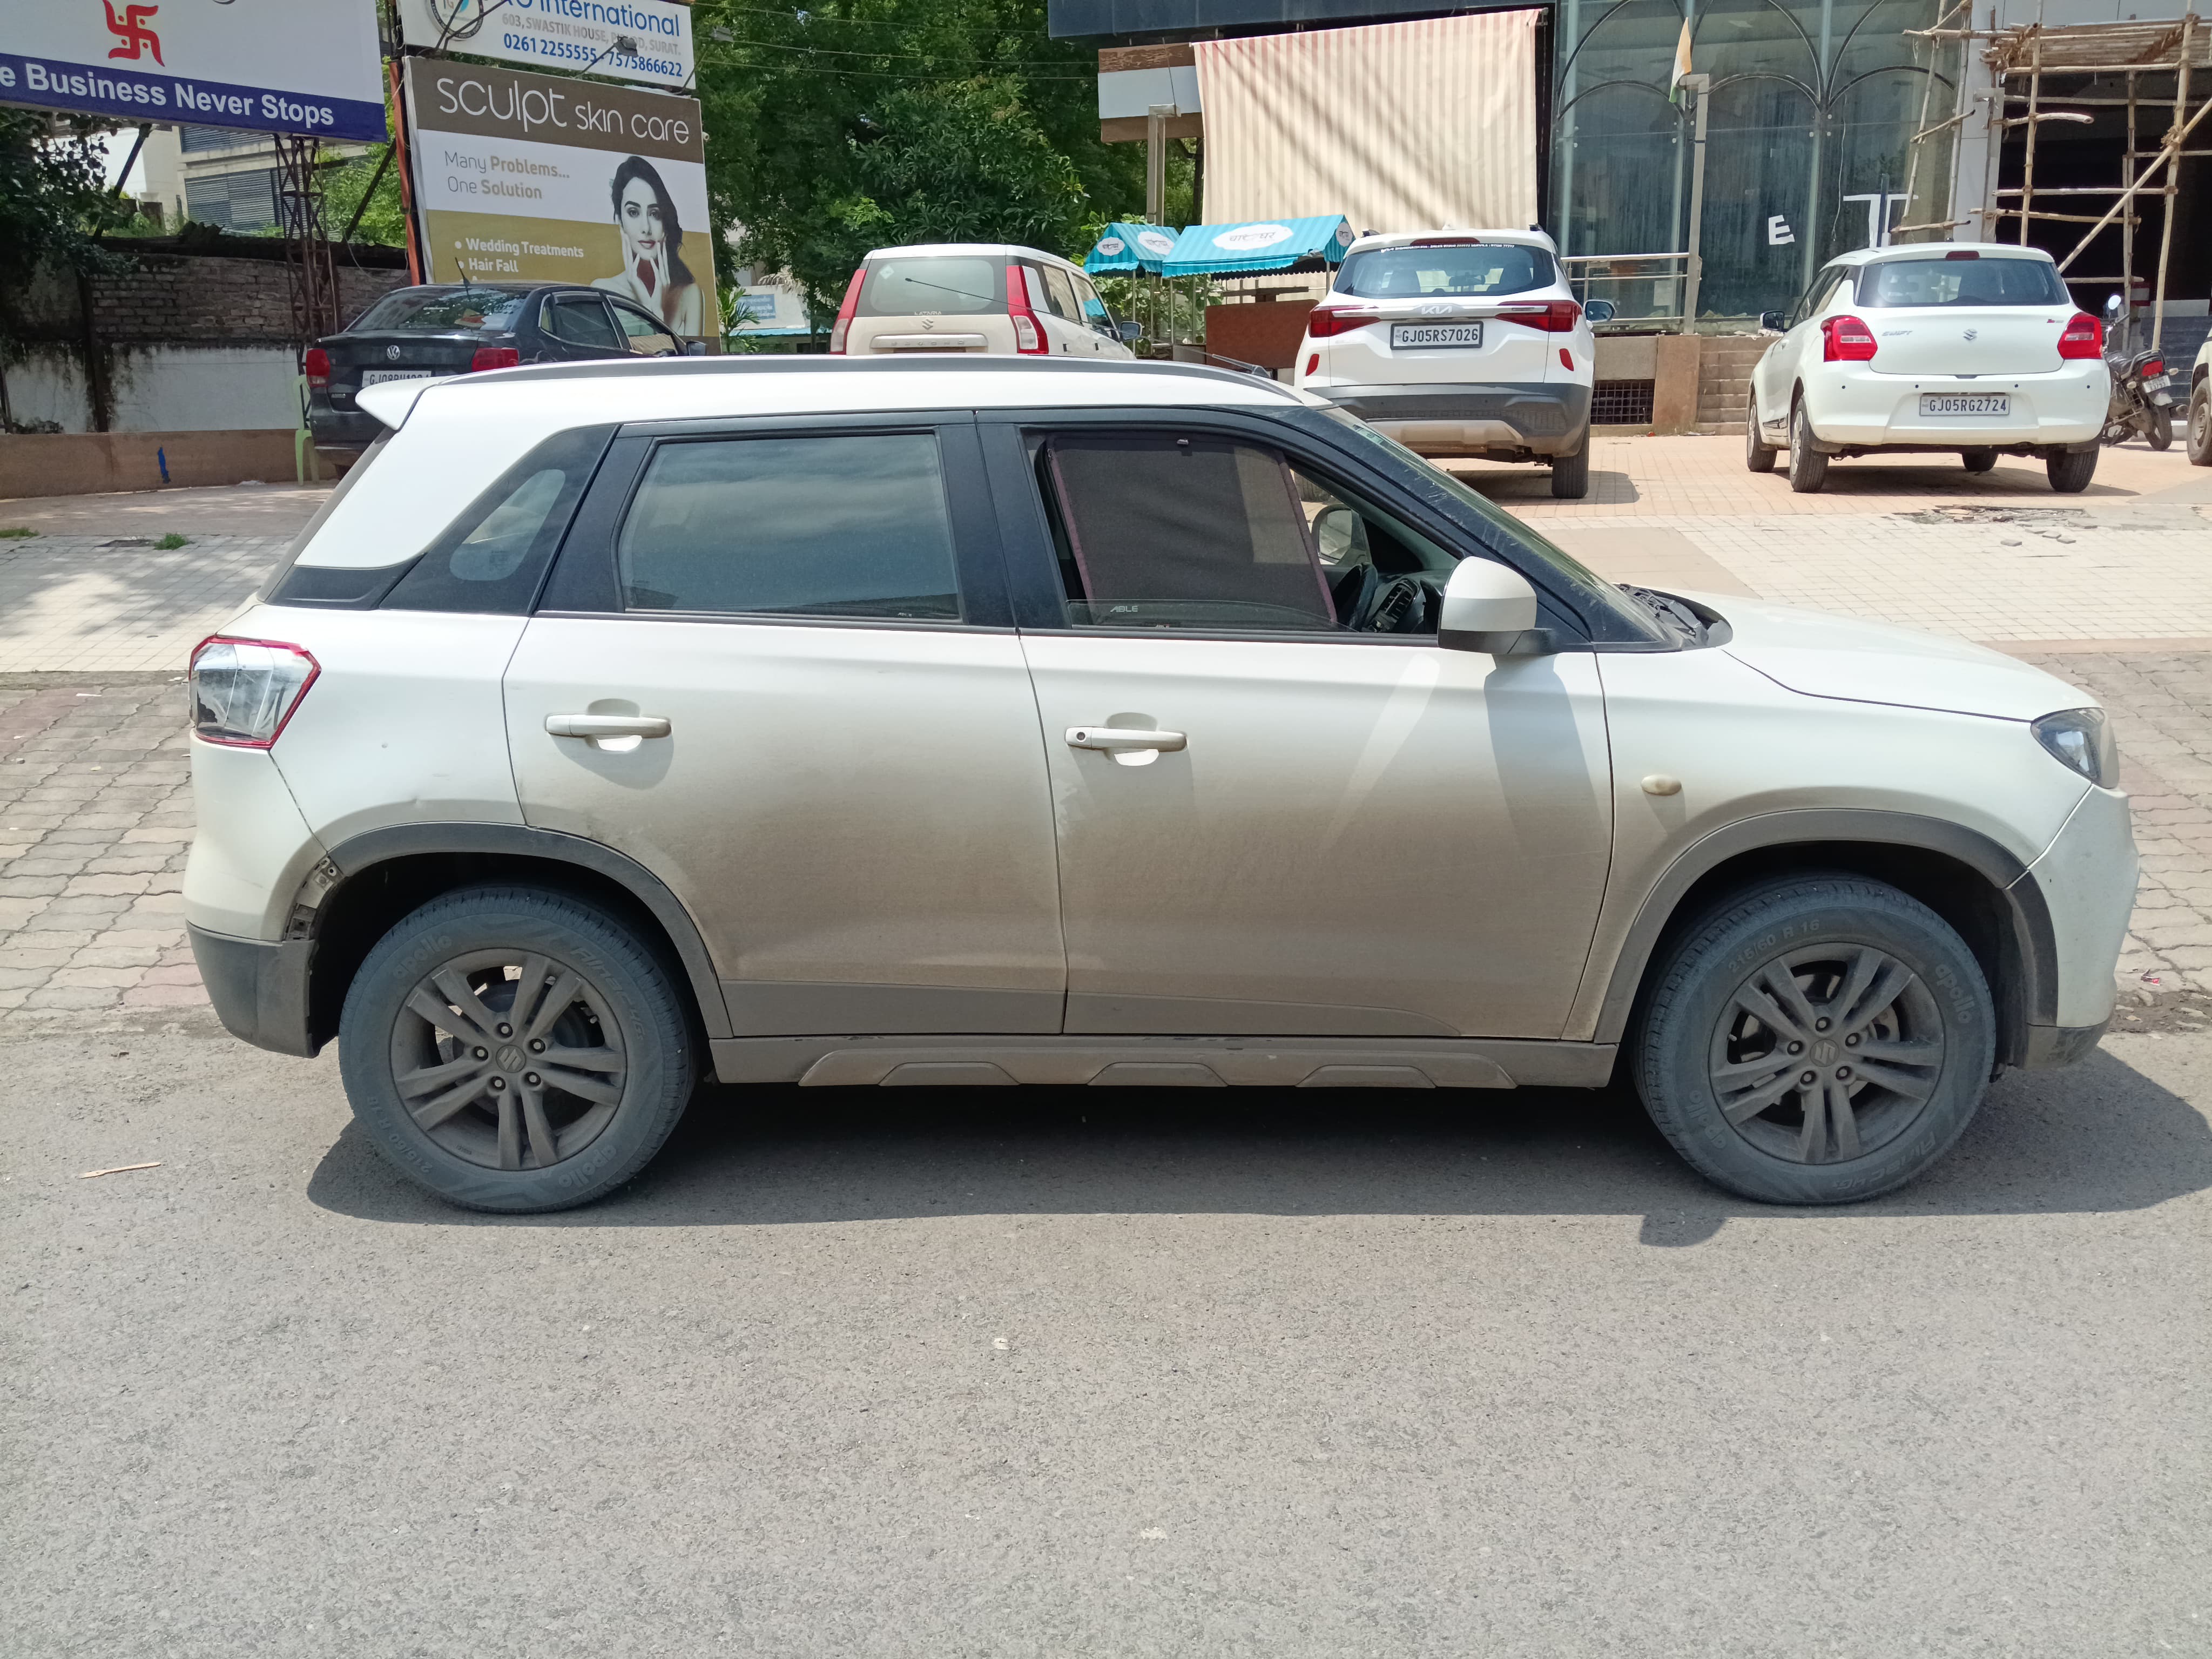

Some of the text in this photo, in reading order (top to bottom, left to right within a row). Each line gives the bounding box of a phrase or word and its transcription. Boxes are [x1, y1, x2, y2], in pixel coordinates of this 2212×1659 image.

[502, 13, 524, 29] 603,
[526, 17, 571, 36] SWASTIK
[573, 24, 609, 44] HOUSE,
[650, 39, 682, 56] SURAT.
[504, 33, 536, 53] 0261
[540, 39, 597, 63] 2255555
[25, 63, 166, 106] Business
[174, 83, 253, 116] Never
[261, 93, 334, 129] Stops
[444, 150, 570, 178] Many Problems...
[447, 176, 543, 199] One Solution
[466, 237, 584, 258] Wedding Treatments
[468, 257, 519, 273] Hair Fall
[1402, 328, 1479, 342] GJ05RS7026
[1930, 399, 2006, 412] GJ05RG2724
[1800, 919, 1820, 933] 16
[393, 935, 453, 979] apollo
[1935, 963, 1975, 1024] apollo
[1684, 1090, 1727, 1149] apollo
[558, 1144, 617, 1188] apollo
